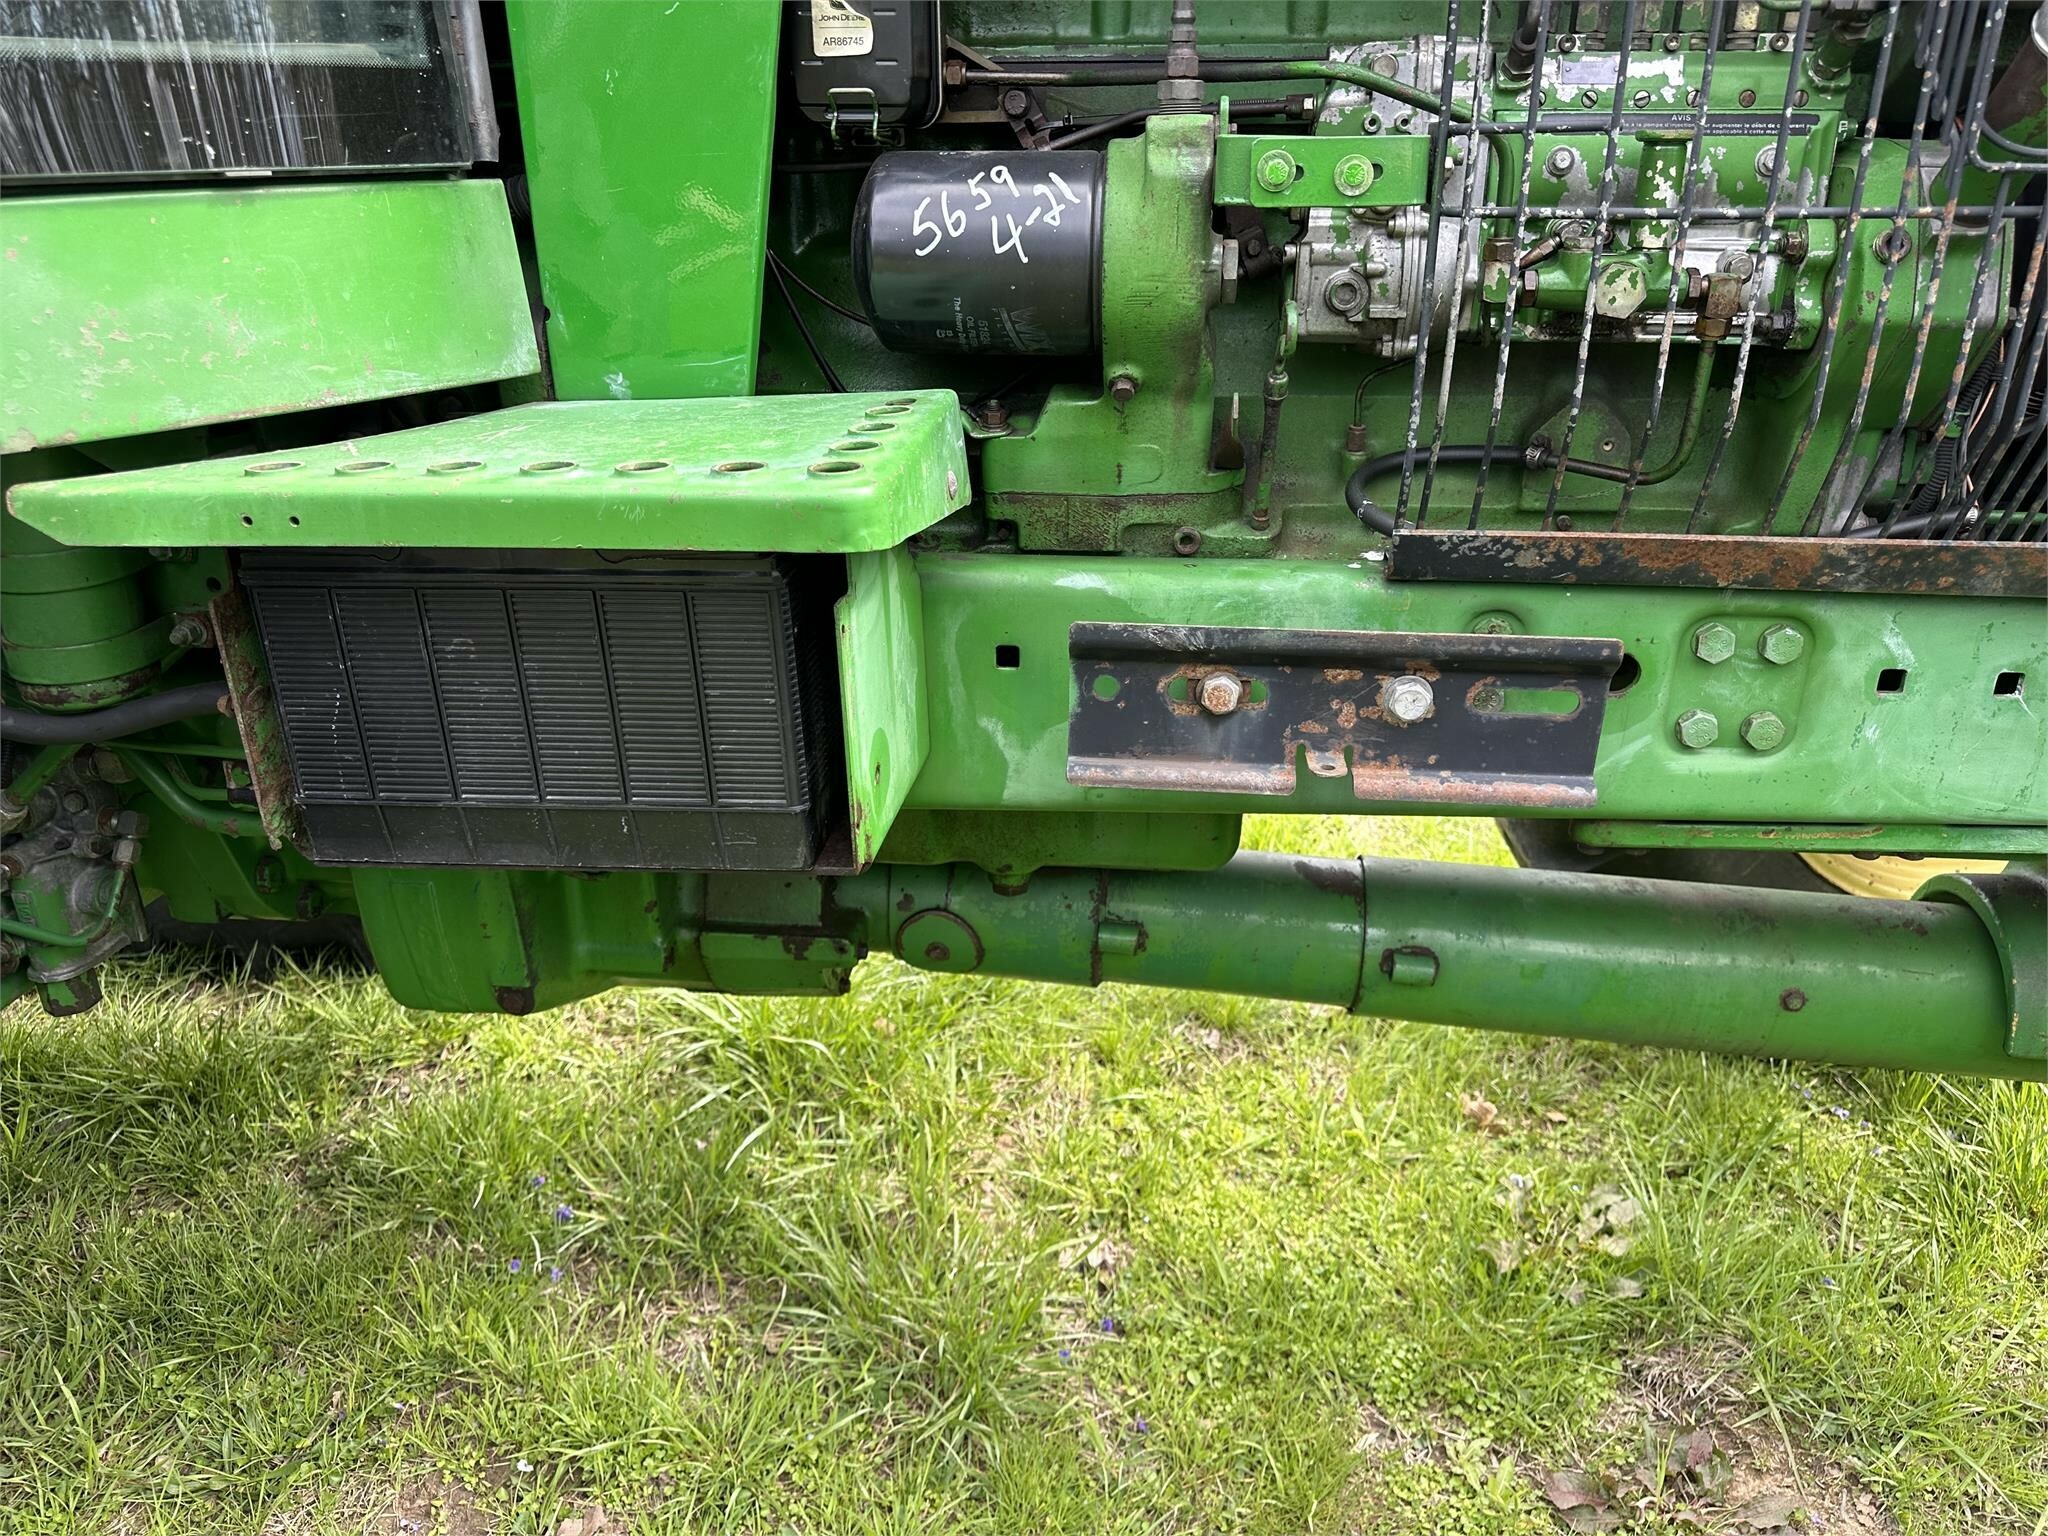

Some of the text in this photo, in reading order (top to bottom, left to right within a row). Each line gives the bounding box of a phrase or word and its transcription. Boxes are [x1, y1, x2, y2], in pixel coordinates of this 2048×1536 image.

[818, 14, 840, 22] JOHN
[822, 36, 865, 46] AR86745
[1671, 114, 1692, 122] AVIS
[913, 165, 1021, 257] 5659
[953, 296, 962, 311] The
[955, 311, 964, 332] Heavy
[965, 315, 975, 328] OIL
